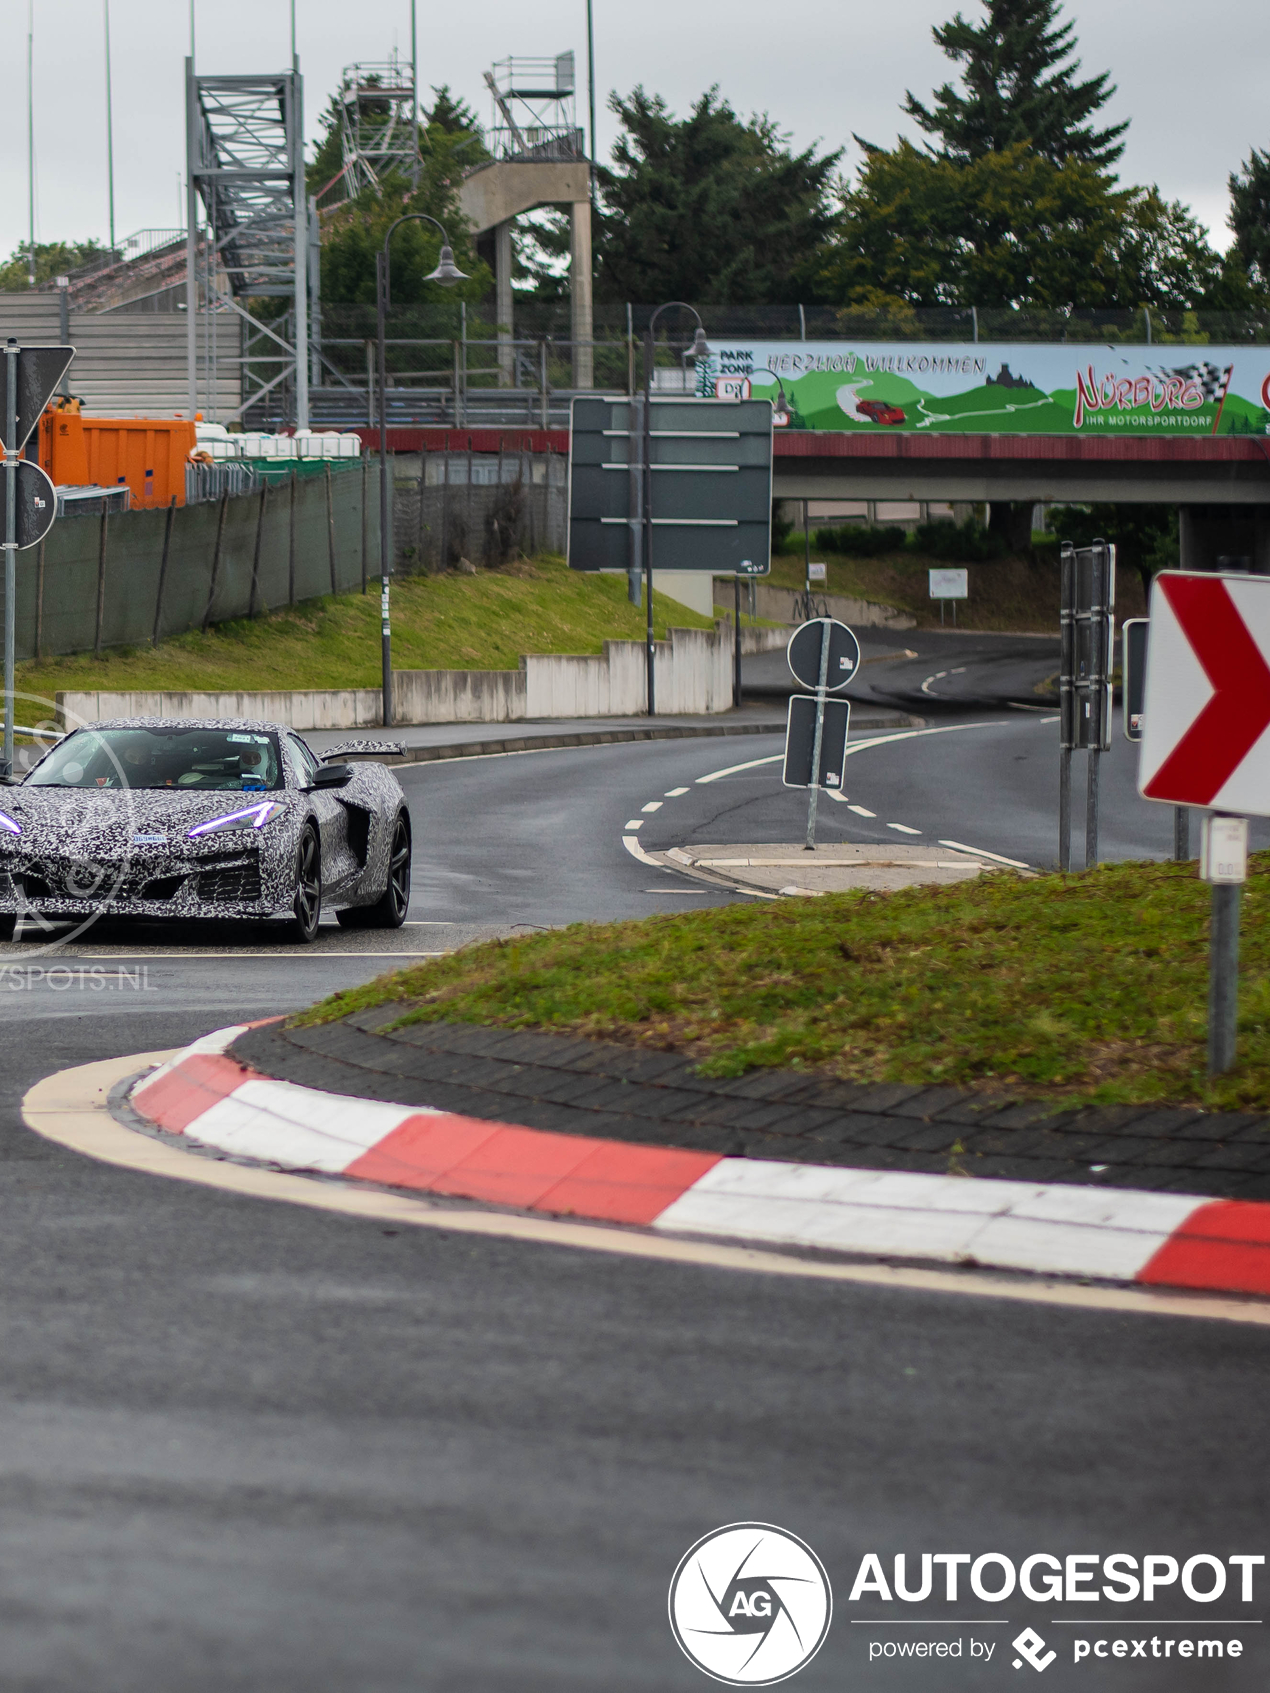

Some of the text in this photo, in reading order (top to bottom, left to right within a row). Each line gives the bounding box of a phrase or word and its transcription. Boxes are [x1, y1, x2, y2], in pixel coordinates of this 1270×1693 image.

[720, 350, 753, 362] PARK
[720, 363, 754, 375] ZONE
[766, 353, 987, 375] HERZLICH WILLKOMMEN
[1073, 364, 1204, 428] NÜRBURG
[1086, 415, 1212, 427] IHR MOTORSPORTDORF
